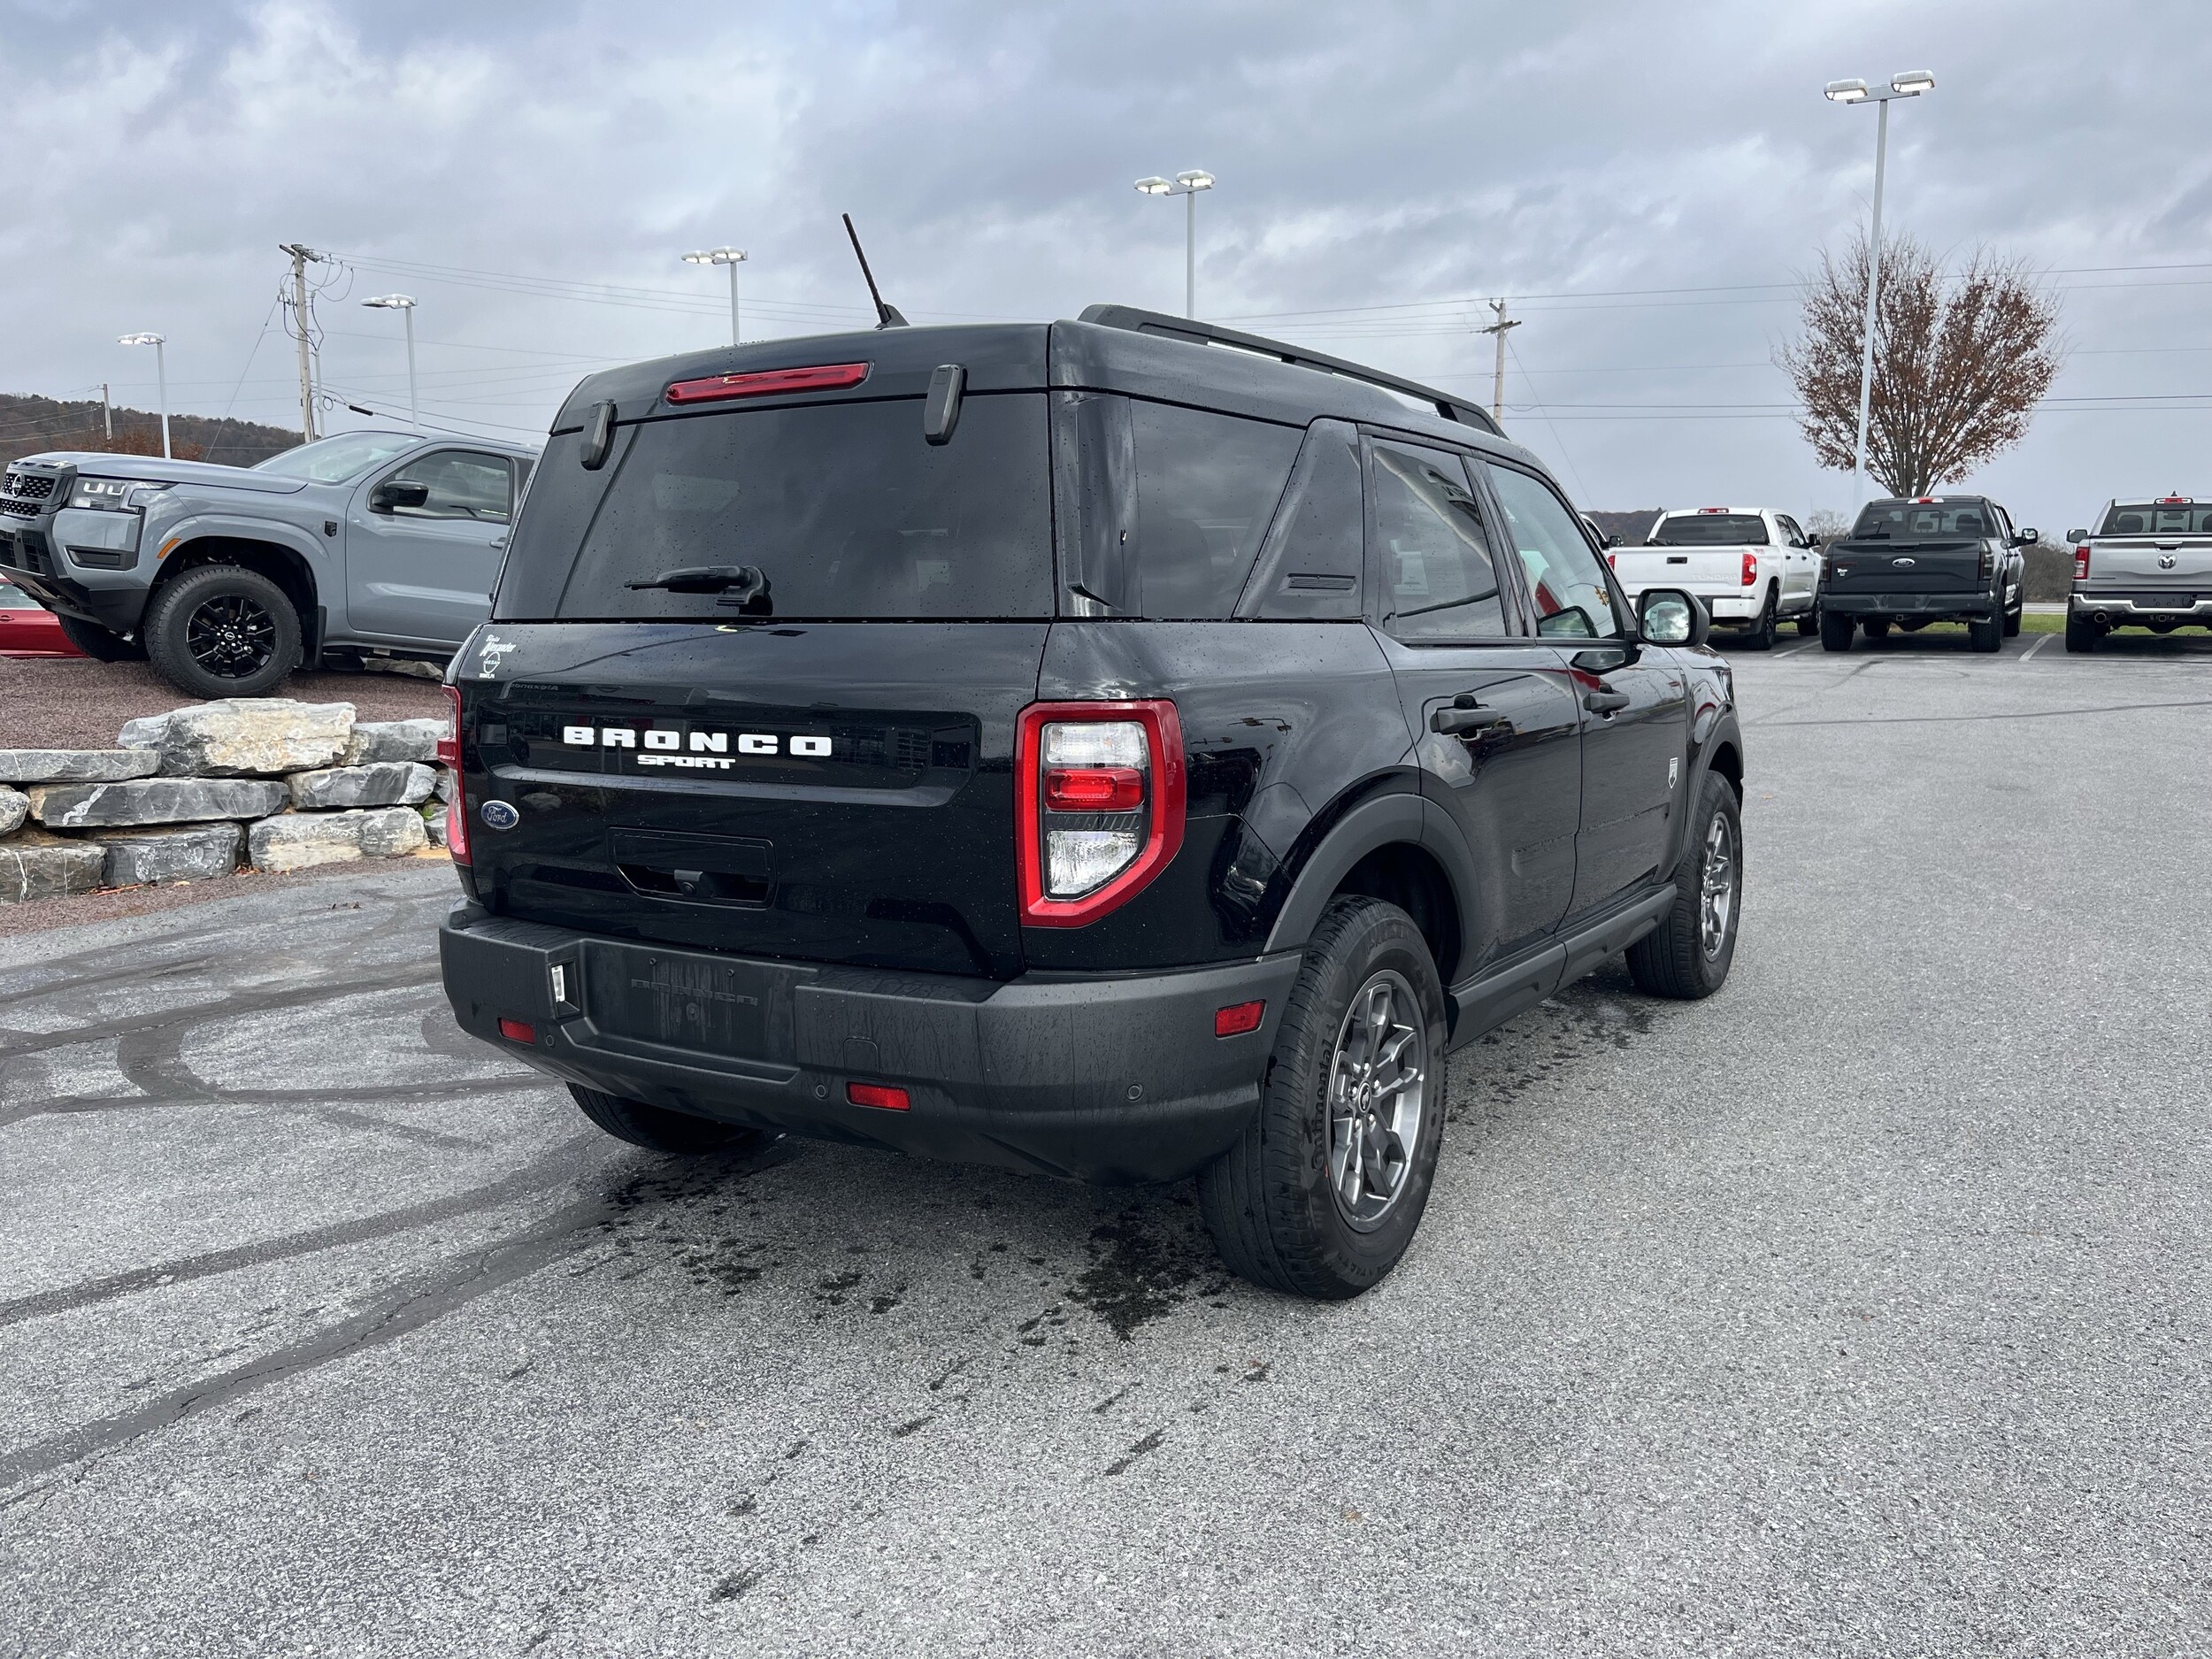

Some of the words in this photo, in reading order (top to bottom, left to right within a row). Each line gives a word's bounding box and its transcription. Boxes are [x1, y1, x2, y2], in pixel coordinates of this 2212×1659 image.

[1691, 572, 1739, 581] TUNDRA
[564, 726, 832, 757] BRONCO
[637, 755, 736, 770] SPORT
